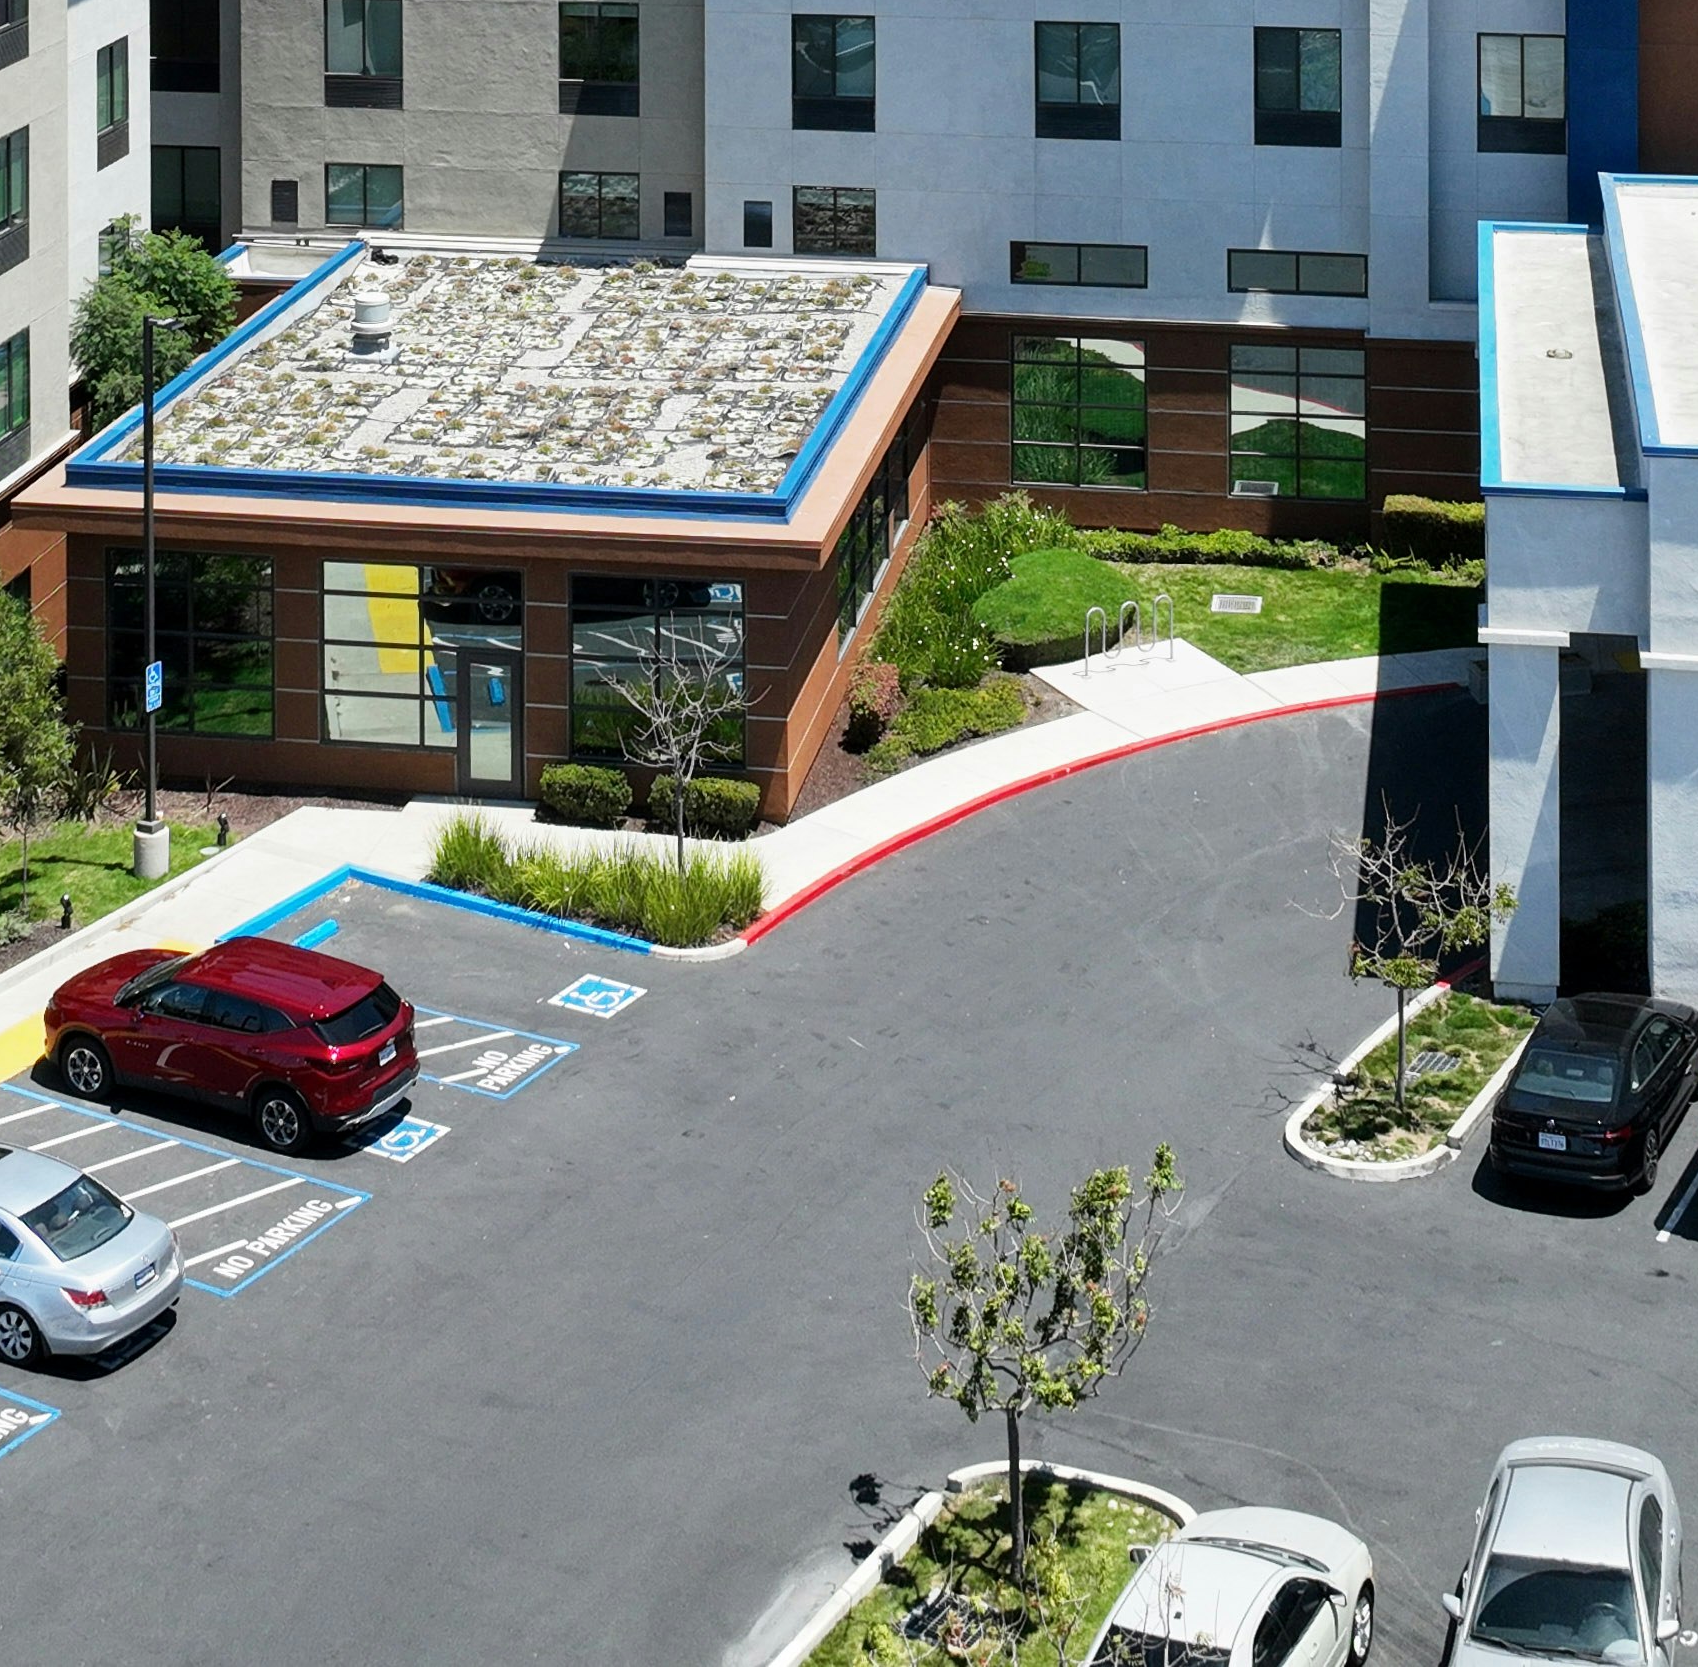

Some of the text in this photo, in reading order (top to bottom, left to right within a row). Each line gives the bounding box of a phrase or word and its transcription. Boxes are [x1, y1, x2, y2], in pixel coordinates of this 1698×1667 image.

[471, 1050, 509, 1070] NO
[476, 1043, 553, 1092] PARKING
[212, 1199, 333, 1280] NO PARKING
